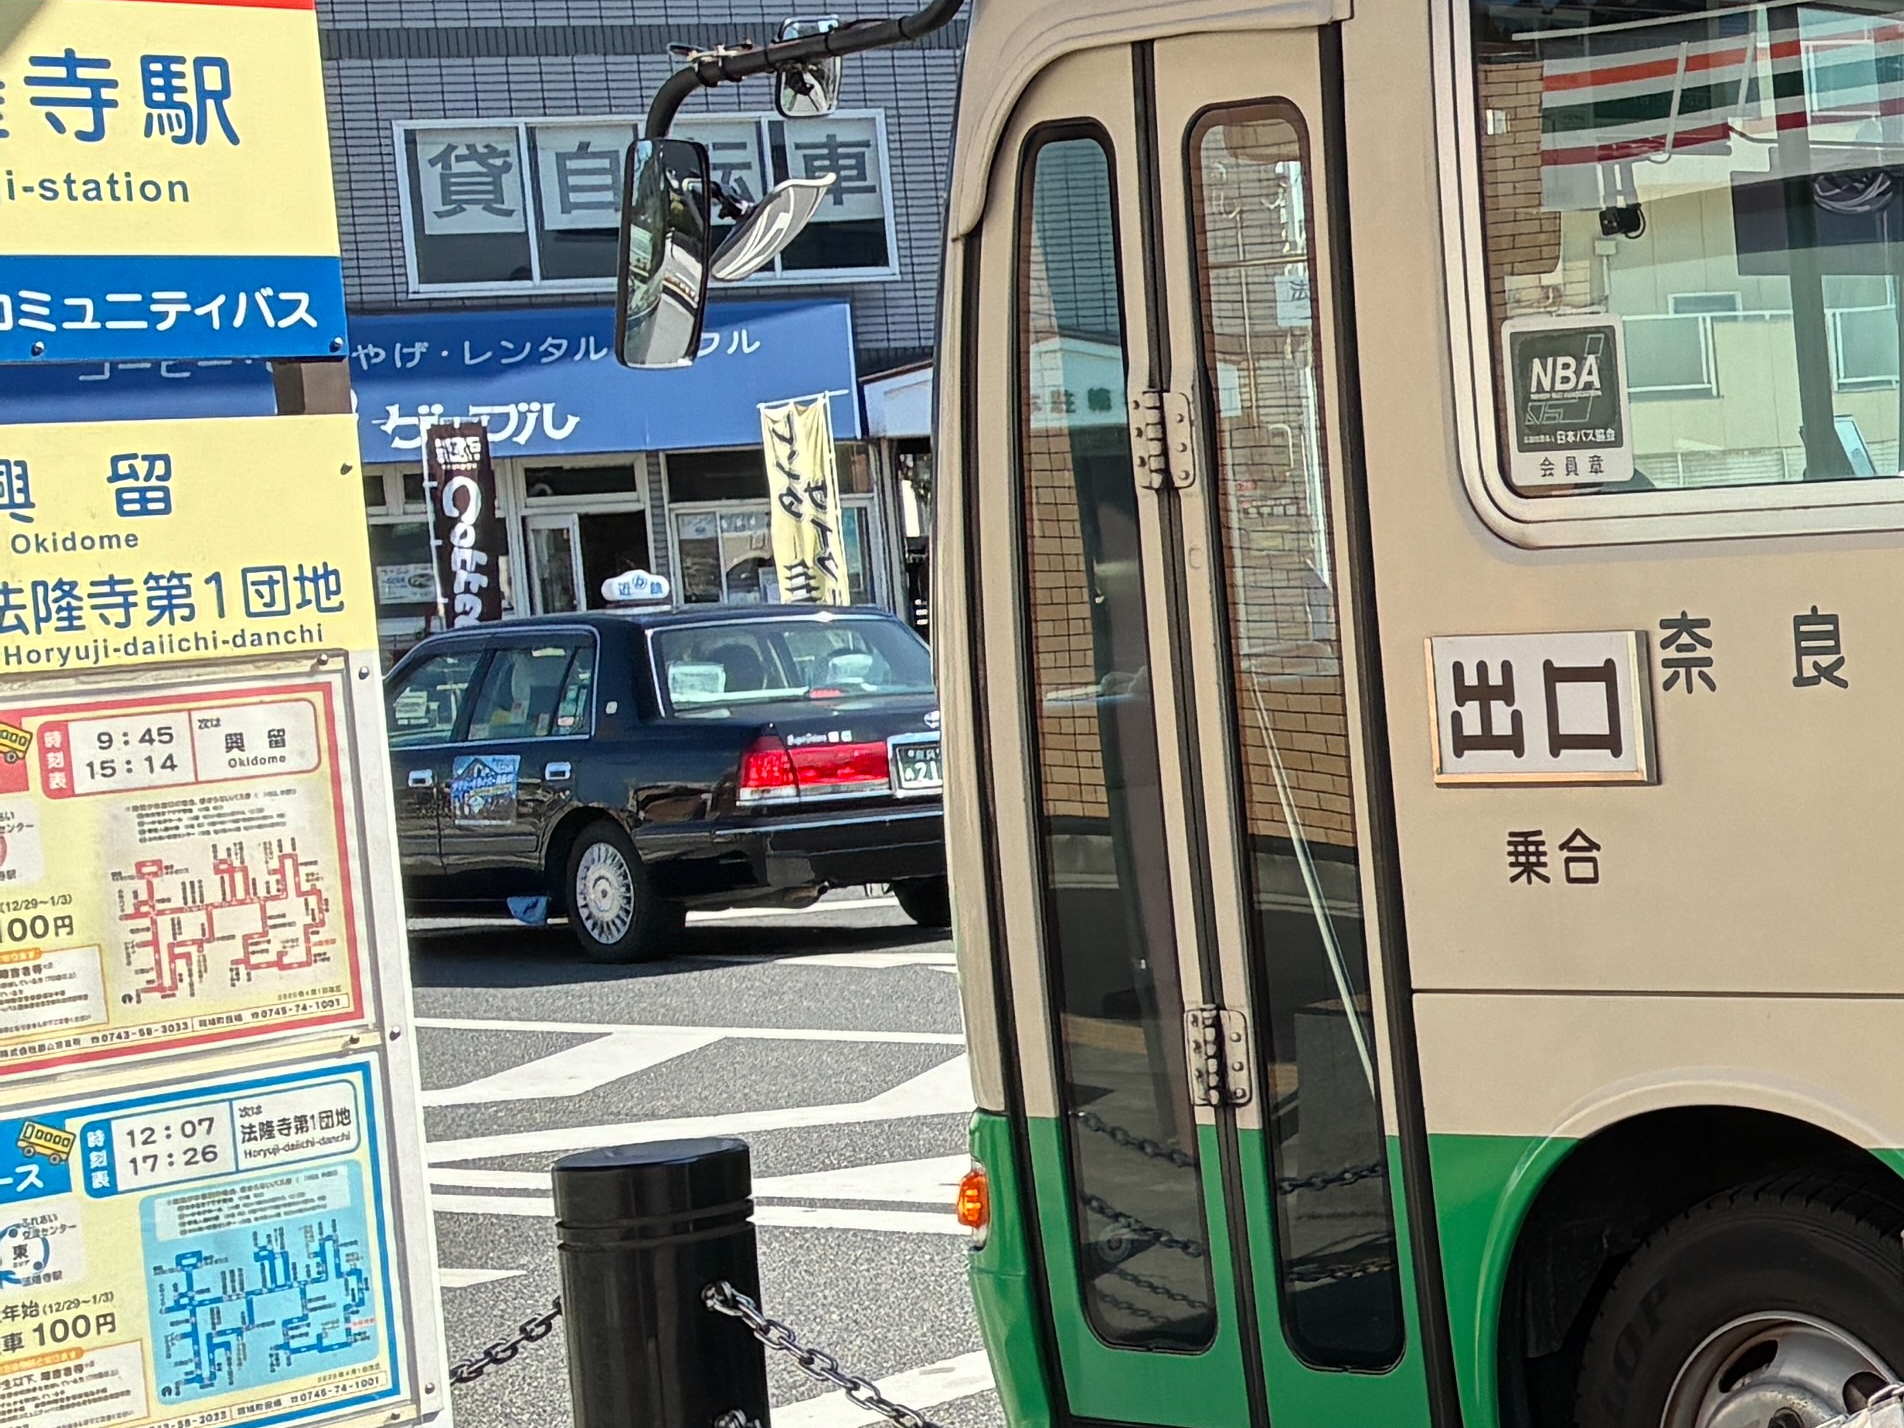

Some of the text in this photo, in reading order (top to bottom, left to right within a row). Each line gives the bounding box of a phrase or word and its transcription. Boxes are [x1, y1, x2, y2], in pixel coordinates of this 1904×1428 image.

[0, 47, 241, 147] 寺駅
[1530, 355, 1602, 393] NBA
[1539, 455, 1604, 478] 会員章
[10, 533, 140, 554] Okidome
[4, 623, 324, 667] Horyuji-daiichi-danchi
[1450, 658, 1625, 761] 出口
[97, 726, 175, 751] 9:45
[86, 753, 178, 780] 15:14
[228, 755, 287, 770] Okidome
[1506, 830, 1602, 886] 乗合
[126, 1117, 215, 1149] 12:07
[240, 1106, 352, 1145] 法隆寺第1団地
[129, 1144, 219, 1176] 17:26
